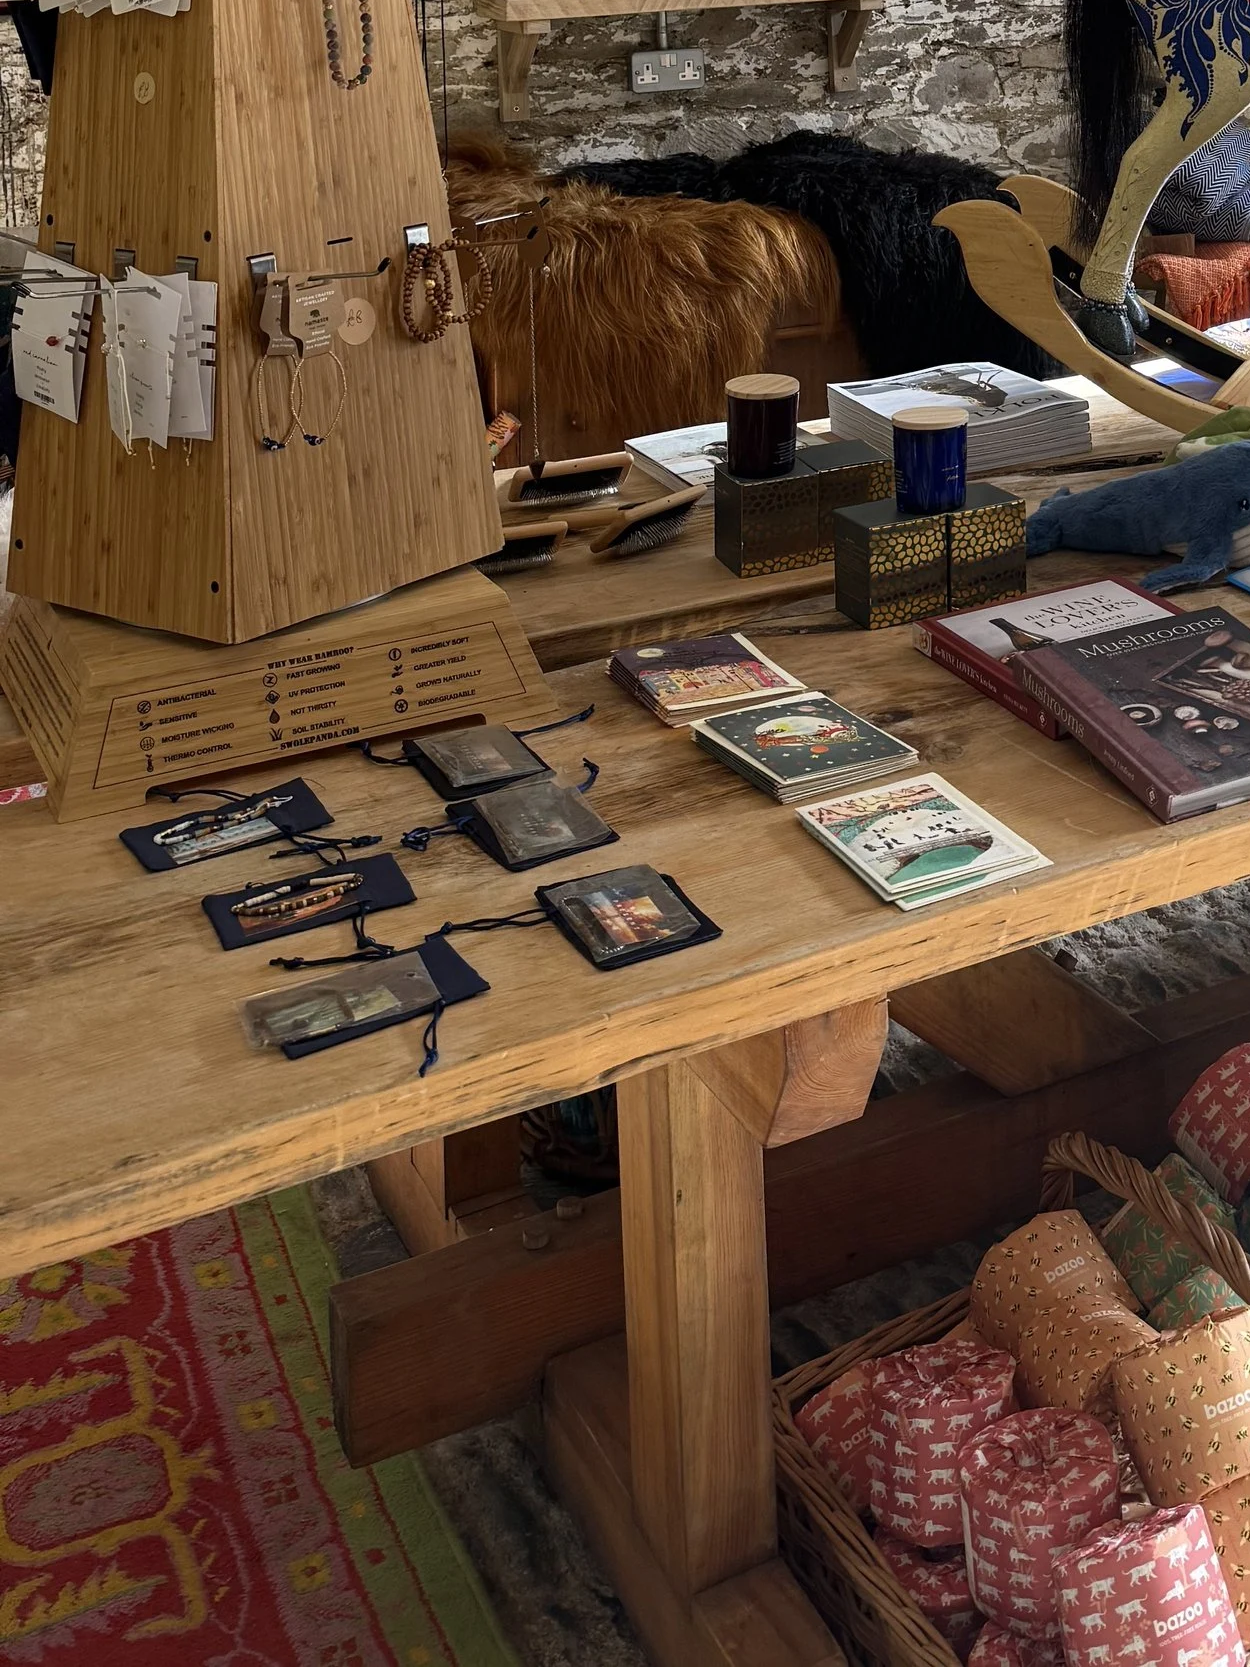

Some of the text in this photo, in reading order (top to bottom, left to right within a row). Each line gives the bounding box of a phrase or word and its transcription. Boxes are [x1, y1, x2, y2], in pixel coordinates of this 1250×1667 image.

[1024, 594, 1112, 622] the WINE
[1032, 598, 1139, 629] LOVER'S
[1069, 613, 1126, 631] kitchen
[411, 637, 469, 654] INCREDIBLY SOFT
[1076, 616, 1226, 658] Mushrooms
[267, 660, 287, 670] WHY
[288, 654, 313, 666] WEAR
[286, 663, 341, 680] FAST GROWING
[413, 655, 466, 671] GREATER YIELD
[940, 649, 956, 668] WINE
[956, 658, 980, 681] LOVER'S
[979, 675, 998, 694] kitchen
[415, 669, 482, 689] GROWS NATURALLY
[157, 688, 217, 707] ANTIBACTERIAL
[288, 681, 346, 698] UV PROTECTION
[418, 689, 476, 707] BIODEGRADABLE
[290, 700, 337, 716] NOT THIRSTY
[1022, 668, 1085, 739] Mushrooms
[159, 711, 198, 725] SENSITIVE
[292, 718, 346, 734] SOIL STABILITY
[161, 722, 235, 744] MOISTURE WICKING
[280, 726, 360, 751] SWOLEPANDA.COM
[163, 743, 233, 763] THERMO CONTROL
[1043, 1256, 1085, 1283] bazoo
[1080, 1309, 1125, 1323] bazoo
[839, 1427, 869, 1454] baz
[1152, 1601, 1204, 1638] bazoo
